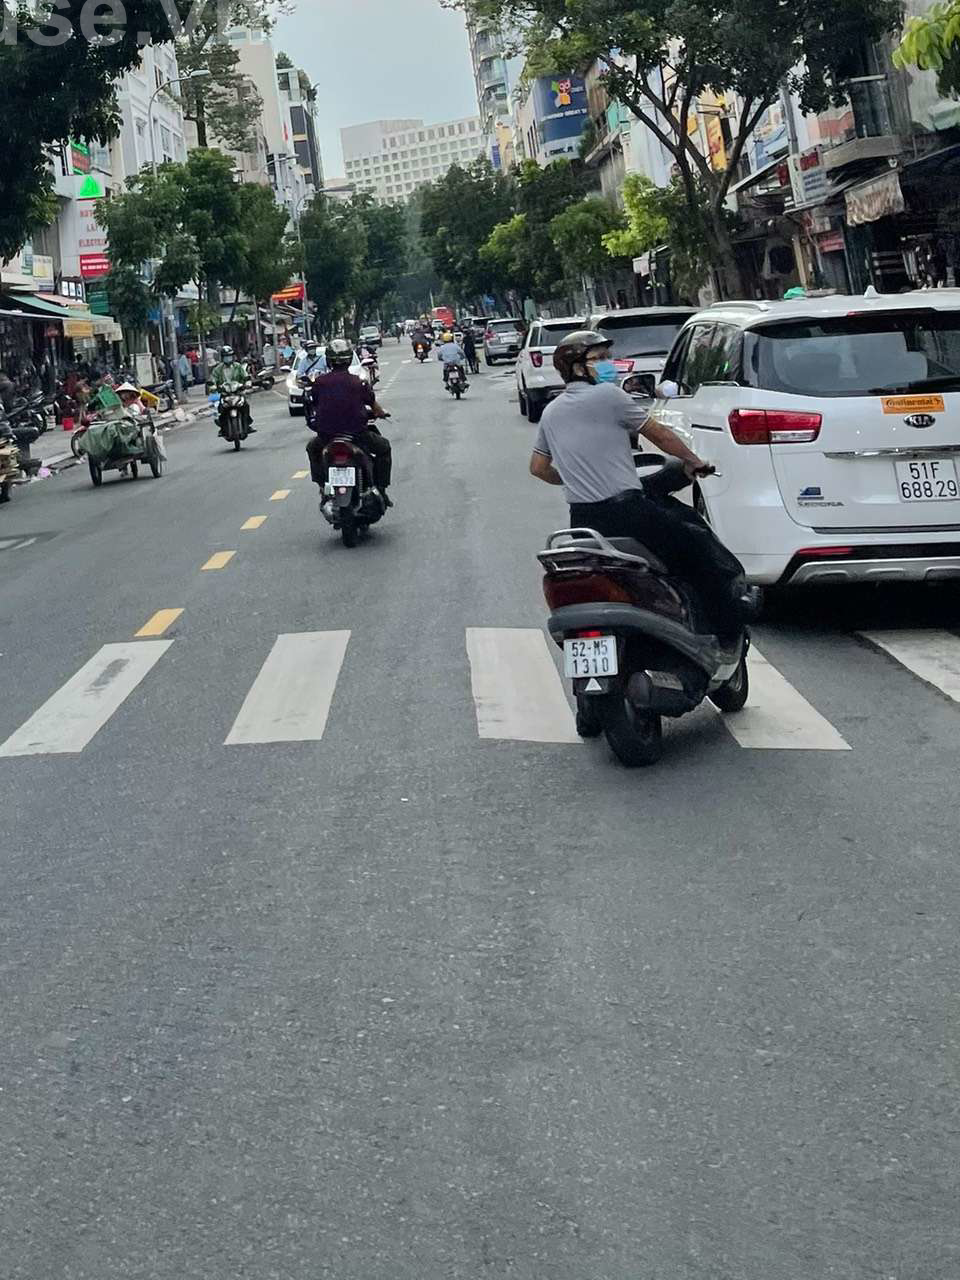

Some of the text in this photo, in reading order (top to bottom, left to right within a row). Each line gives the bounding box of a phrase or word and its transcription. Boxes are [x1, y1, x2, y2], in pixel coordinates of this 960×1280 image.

[908, 415, 932, 425] KIA
[908, 462, 940, 480] 51F
[901, 480, 958, 499] 688.29
[572, 640, 608, 657] 52-M5
[573, 657, 609, 674] 1310
